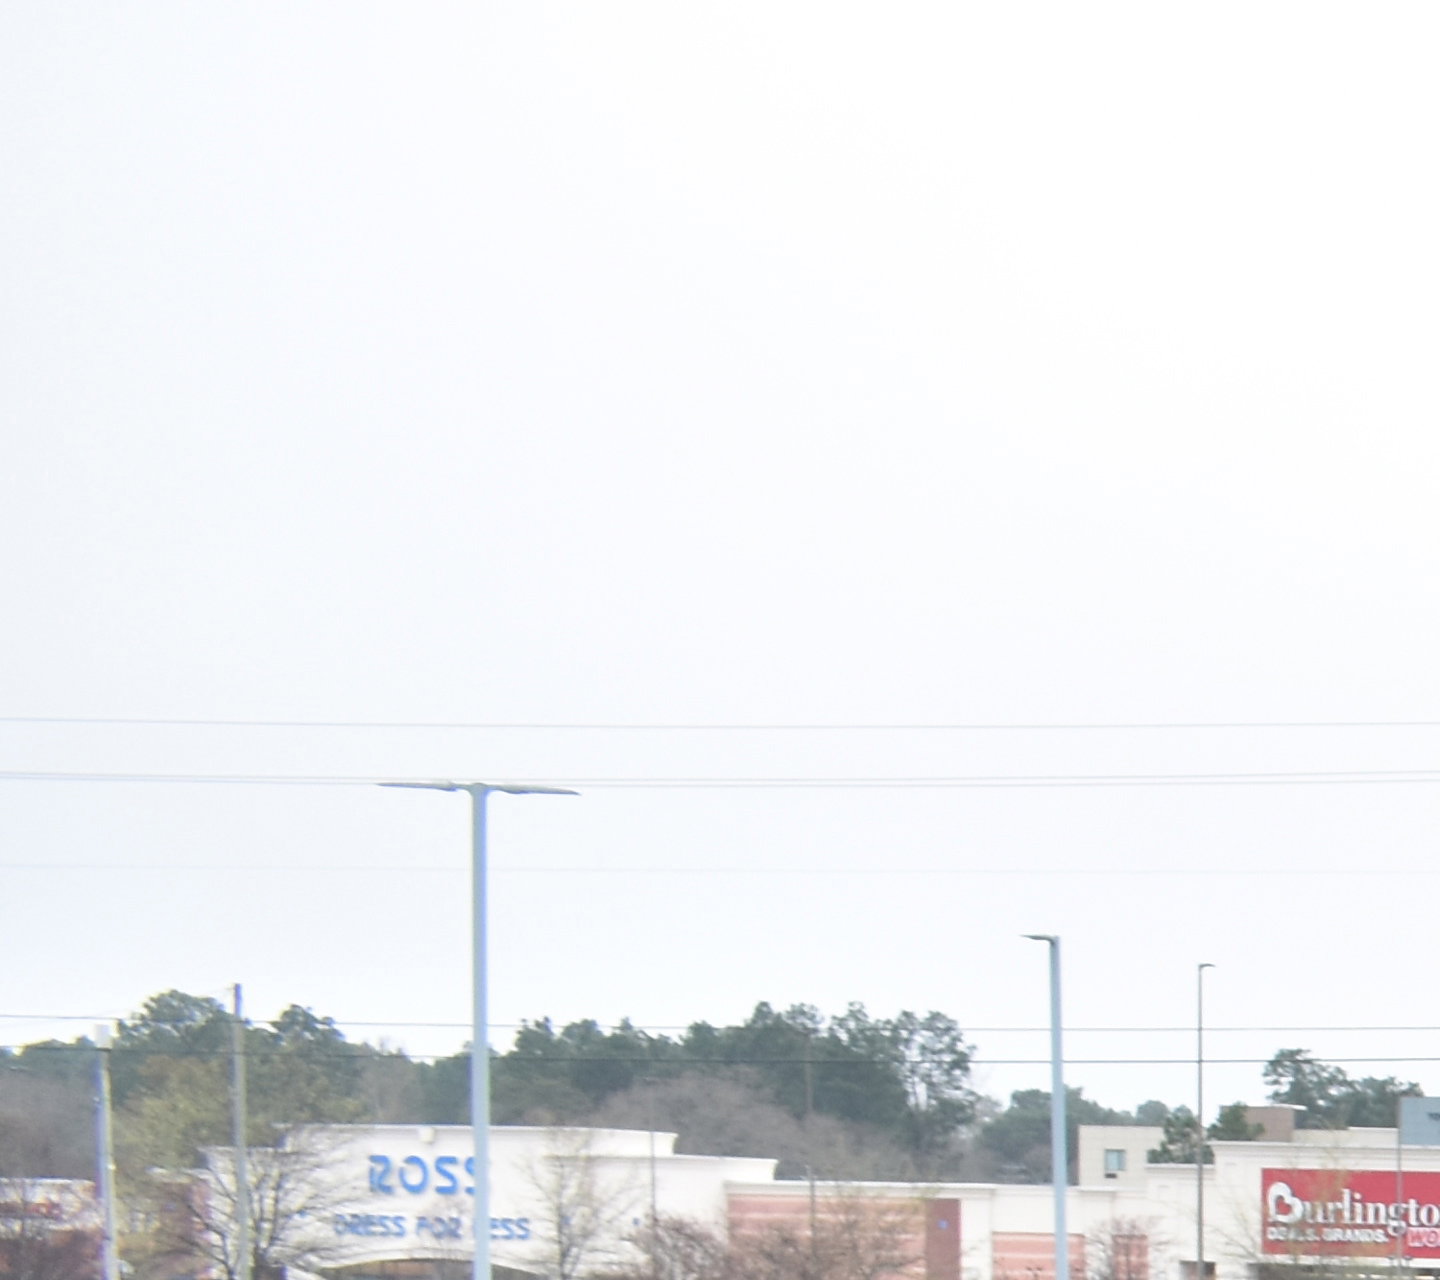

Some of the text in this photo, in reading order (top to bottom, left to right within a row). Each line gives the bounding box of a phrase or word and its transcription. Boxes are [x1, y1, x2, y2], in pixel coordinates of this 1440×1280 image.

[333, 1213, 531, 1240] DRESS FOR ESS
